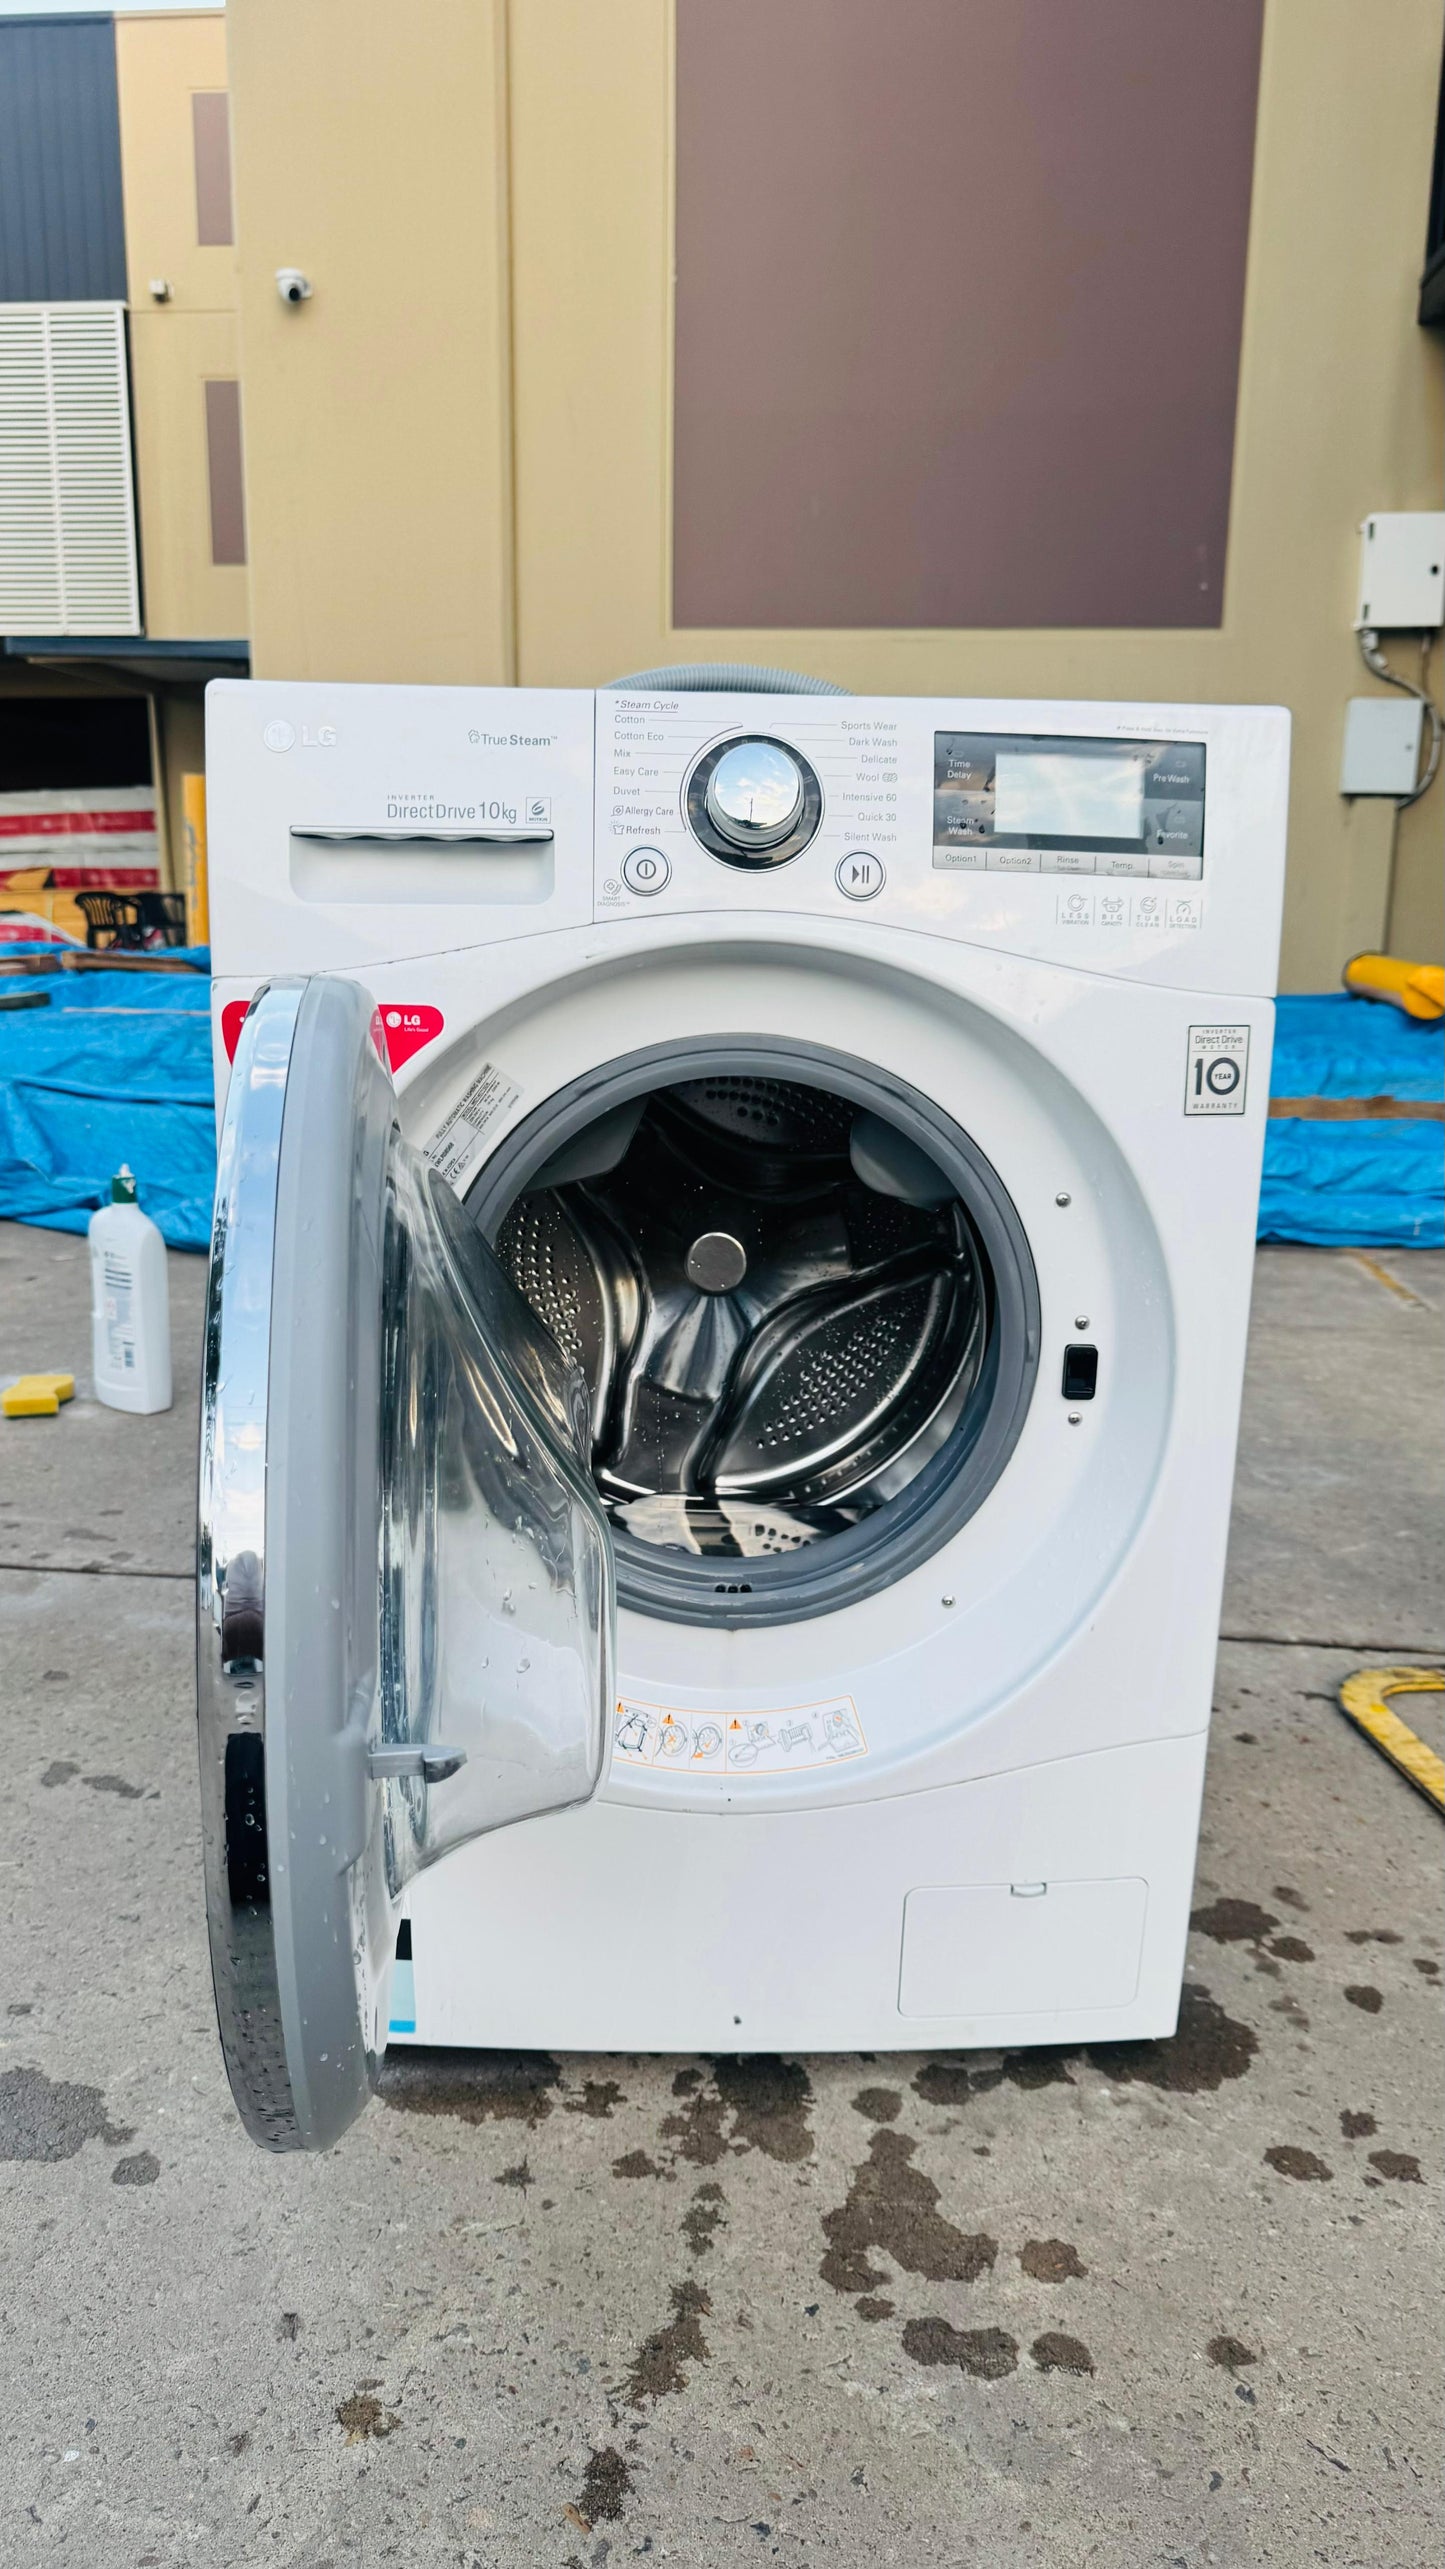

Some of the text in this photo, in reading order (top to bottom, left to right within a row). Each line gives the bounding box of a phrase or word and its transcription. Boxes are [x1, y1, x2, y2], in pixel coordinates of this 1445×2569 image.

[653, 701, 679, 711] Cycle
[614, 714, 646, 724] Cotton
[841, 720, 898, 731] Sports Wear
[302, 725, 337, 747] LG
[614, 731, 664, 741] Cotton Eco
[849, 737, 898, 748] Dark Wash
[613, 748, 631, 758] Mix
[861, 754, 898, 765] Delicate
[949, 760, 971, 768] Time
[613, 766, 659, 777] Easy Care
[947, 770, 972, 780] Delay
[856, 772, 880, 782] Wool
[613, 786, 641, 796] Duvet
[842, 793, 898, 802] Intensive 60
[625, 806, 674, 817] Allergy Care
[858, 812, 897, 822] Quick 30
[626, 826, 661, 835] Refresh
[948, 827, 973, 836] Wash
[1157, 829, 1189, 840] Favorite
[844, 832, 897, 842] Silent Wash
[945, 854, 977, 863] Option1
[999, 856, 1032, 865] Option2
[1057, 855, 1080, 864] Rinse
[403, 1014, 421, 1026] LG
[1195, 1035, 1244, 1044] Direct Drive
[1194, 1056, 1241, 1096] 10
[1192, 1102, 1238, 1110] WARRANTY
